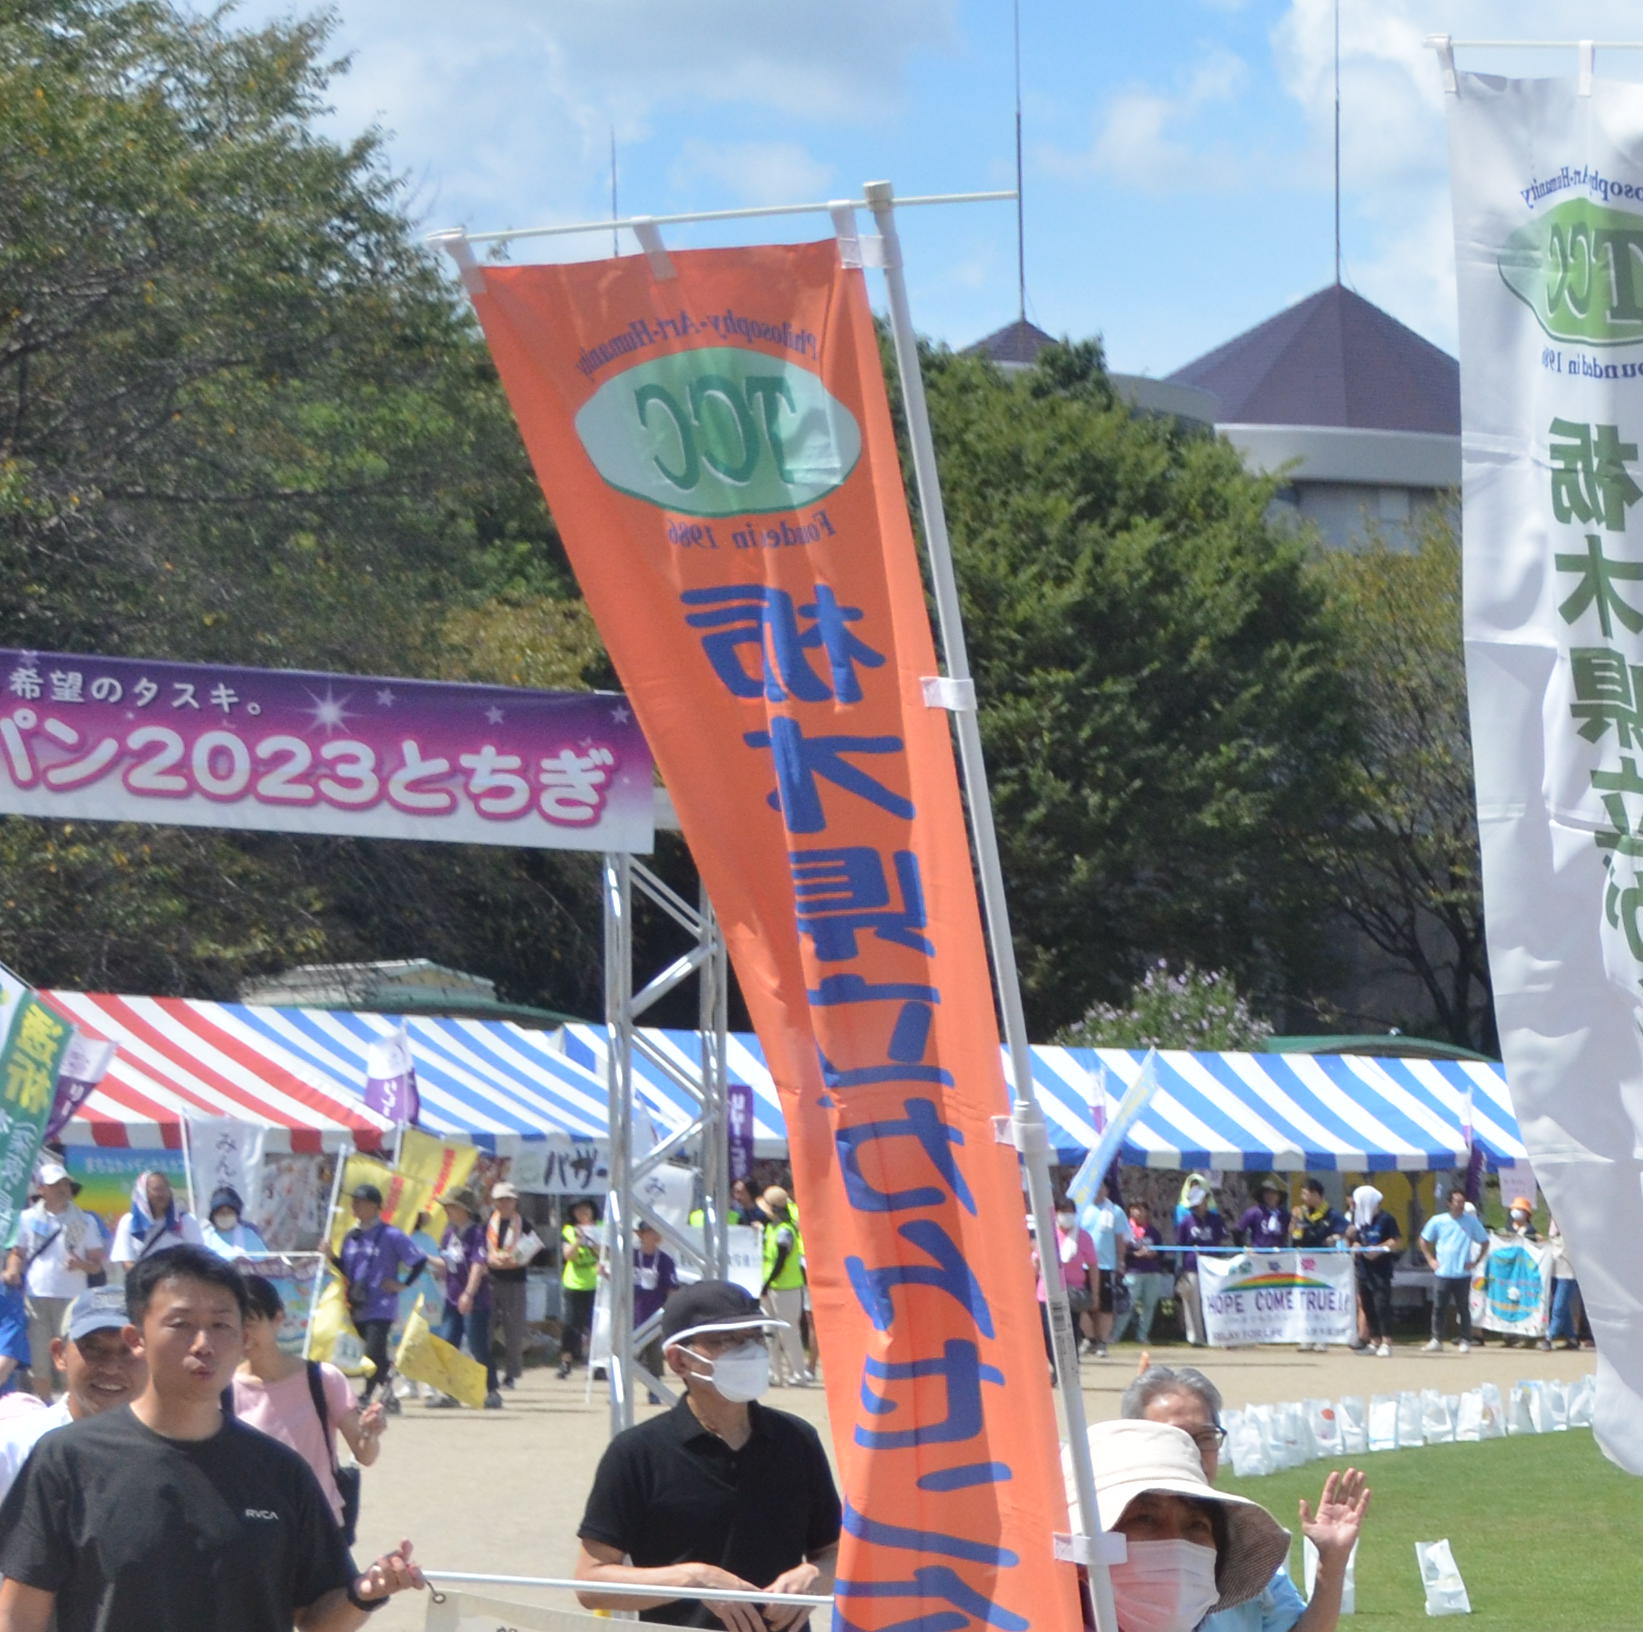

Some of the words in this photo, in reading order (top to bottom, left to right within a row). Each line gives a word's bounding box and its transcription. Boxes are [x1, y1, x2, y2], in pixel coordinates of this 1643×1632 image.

[9, 667, 264, 718] 希望のタスキ。
[543, 1149, 610, 1191] バザ
[1207, 1294, 1245, 1315] HOPE
[1255, 1290, 1295, 1313] COME
[244, 1508, 279, 1521] RVCA
